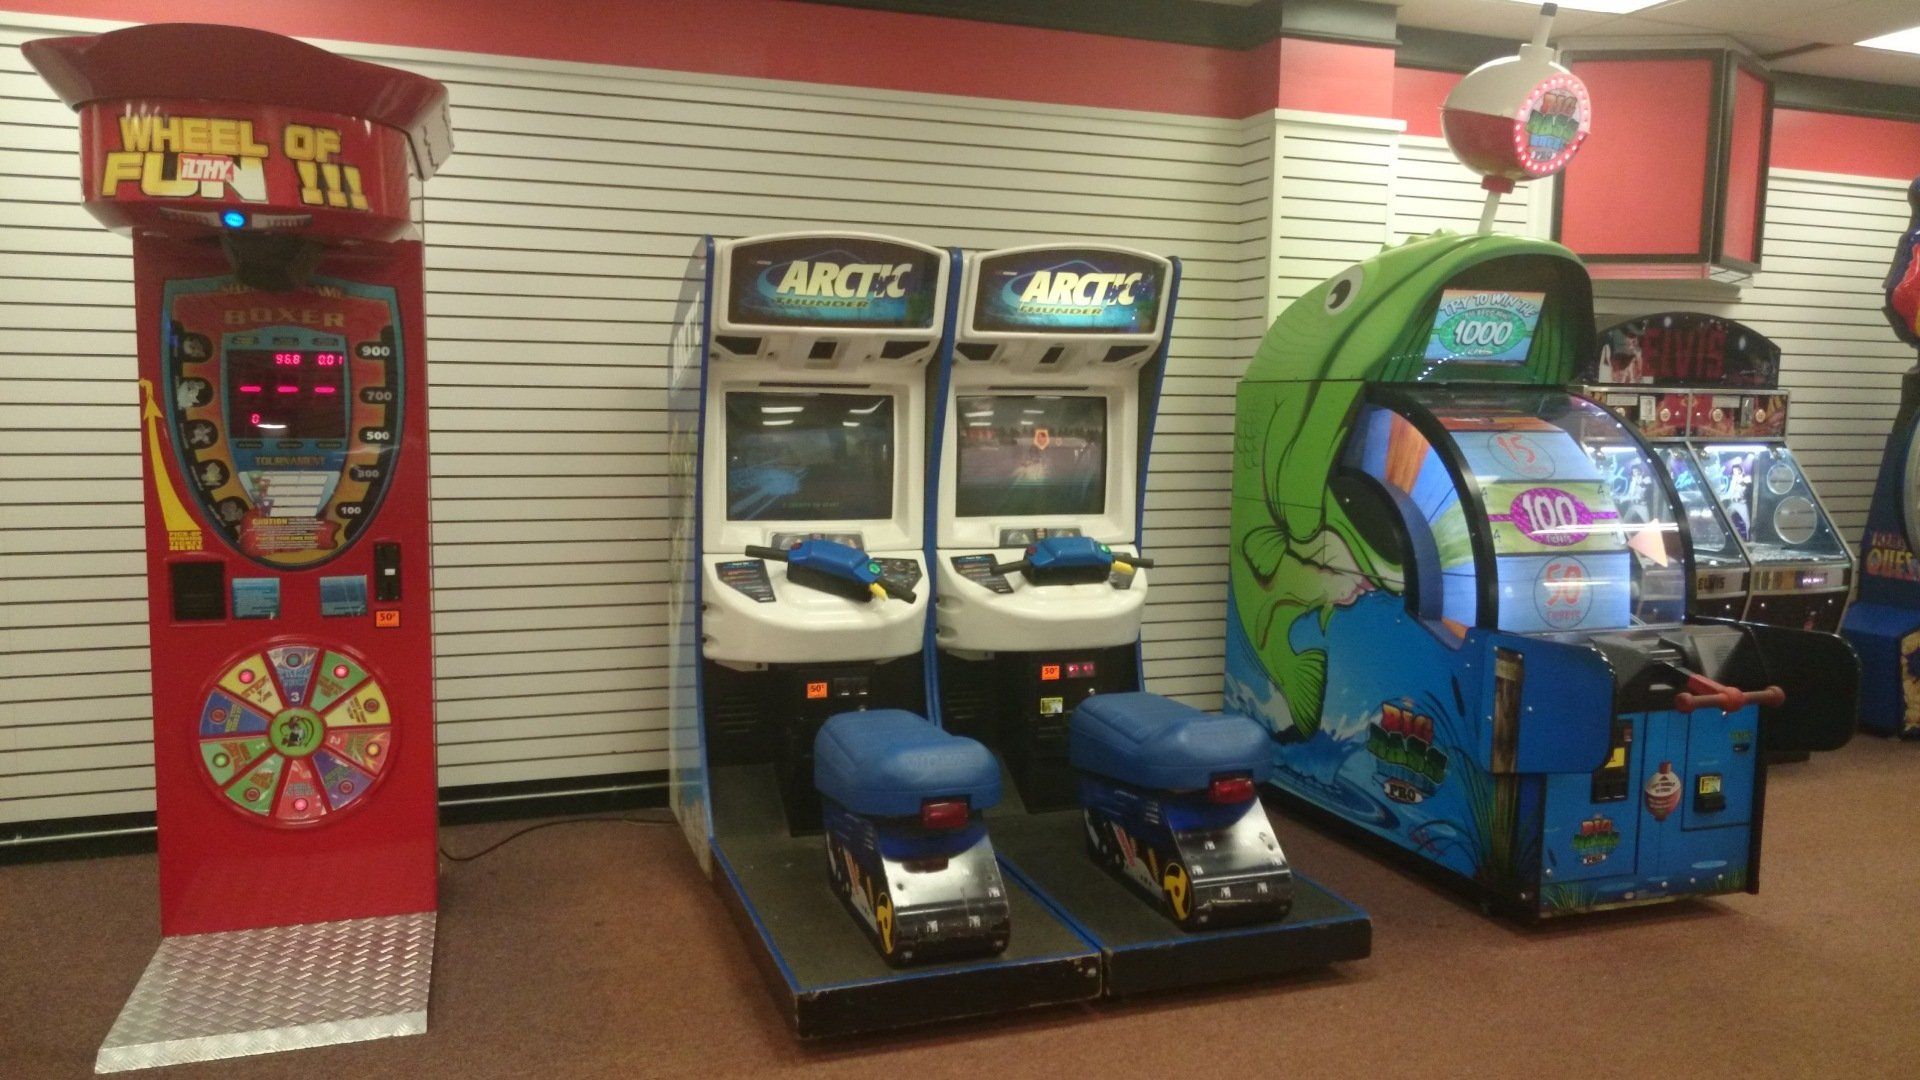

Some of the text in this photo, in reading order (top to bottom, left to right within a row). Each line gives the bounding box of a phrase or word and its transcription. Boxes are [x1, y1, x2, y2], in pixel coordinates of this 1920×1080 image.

[119, 114, 341, 162] WHEEL OF
[102, 152, 269, 204] FUN
[776, 260, 913, 299] ARCTIC
[1020, 270, 1143, 307] ARCTIC
[774, 297, 868, 308] THUNDER
[1019, 306, 1103, 315] THUNDER
[1441, 297, 1471, 316] TRY
[1473, 293, 1488, 306] TO
[1490, 293, 1517, 309] WIN
[224, 307, 345, 327] BOXER
[1454, 320, 1513, 346] 1000
[361, 346, 391, 356] 900
[1643, 327, 1728, 380] ELVIS
[366, 391, 392, 401] 700
[366, 431, 390, 441] 500
[1497, 434, 1536, 463] 15
[255, 456, 326, 466] TOURNAMENT
[358, 469, 379, 478] 300
[340, 506, 361, 515] 100
[1522, 494, 1578, 531] 100
[1545, 563, 1582, 606] 50
[291, 692, 300, 702] 3
[1381, 703, 1434, 744] BIG
[1389, 783, 1417, 802] PRO
